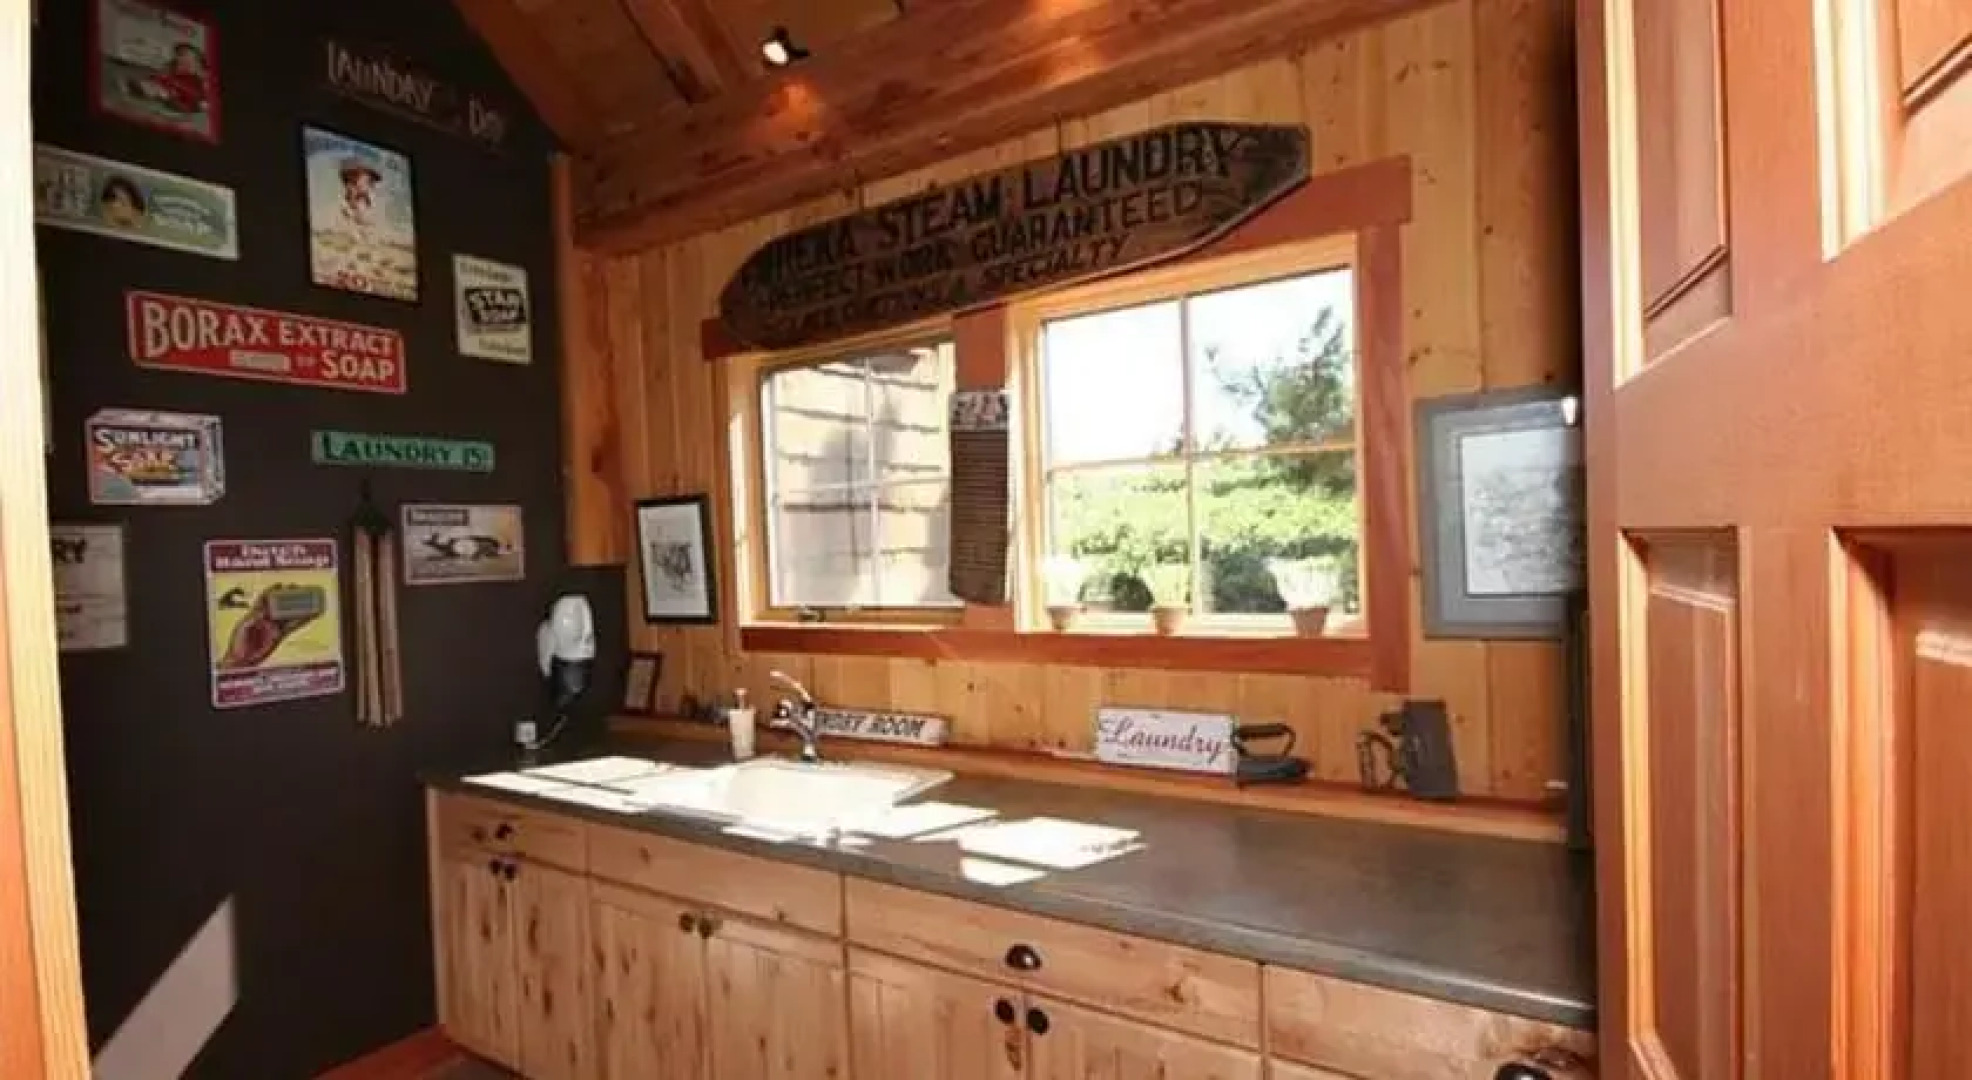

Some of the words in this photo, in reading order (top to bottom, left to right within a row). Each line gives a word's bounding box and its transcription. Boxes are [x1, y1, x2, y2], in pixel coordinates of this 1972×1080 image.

[878, 174, 1005, 247] STEAM
[1022, 126, 1238, 209] LAUNDRY
[972, 180, 1202, 262] GUARANTEED
[982, 232, 1130, 284] SPECIALTY
[141, 301, 269, 359] BORAX
[278, 318, 393, 355] EXTRACT
[320, 349, 394, 381] SOAP
[94, 428, 199, 453] SUNLIGHT
[1100, 715, 1222, 766] Laundry
